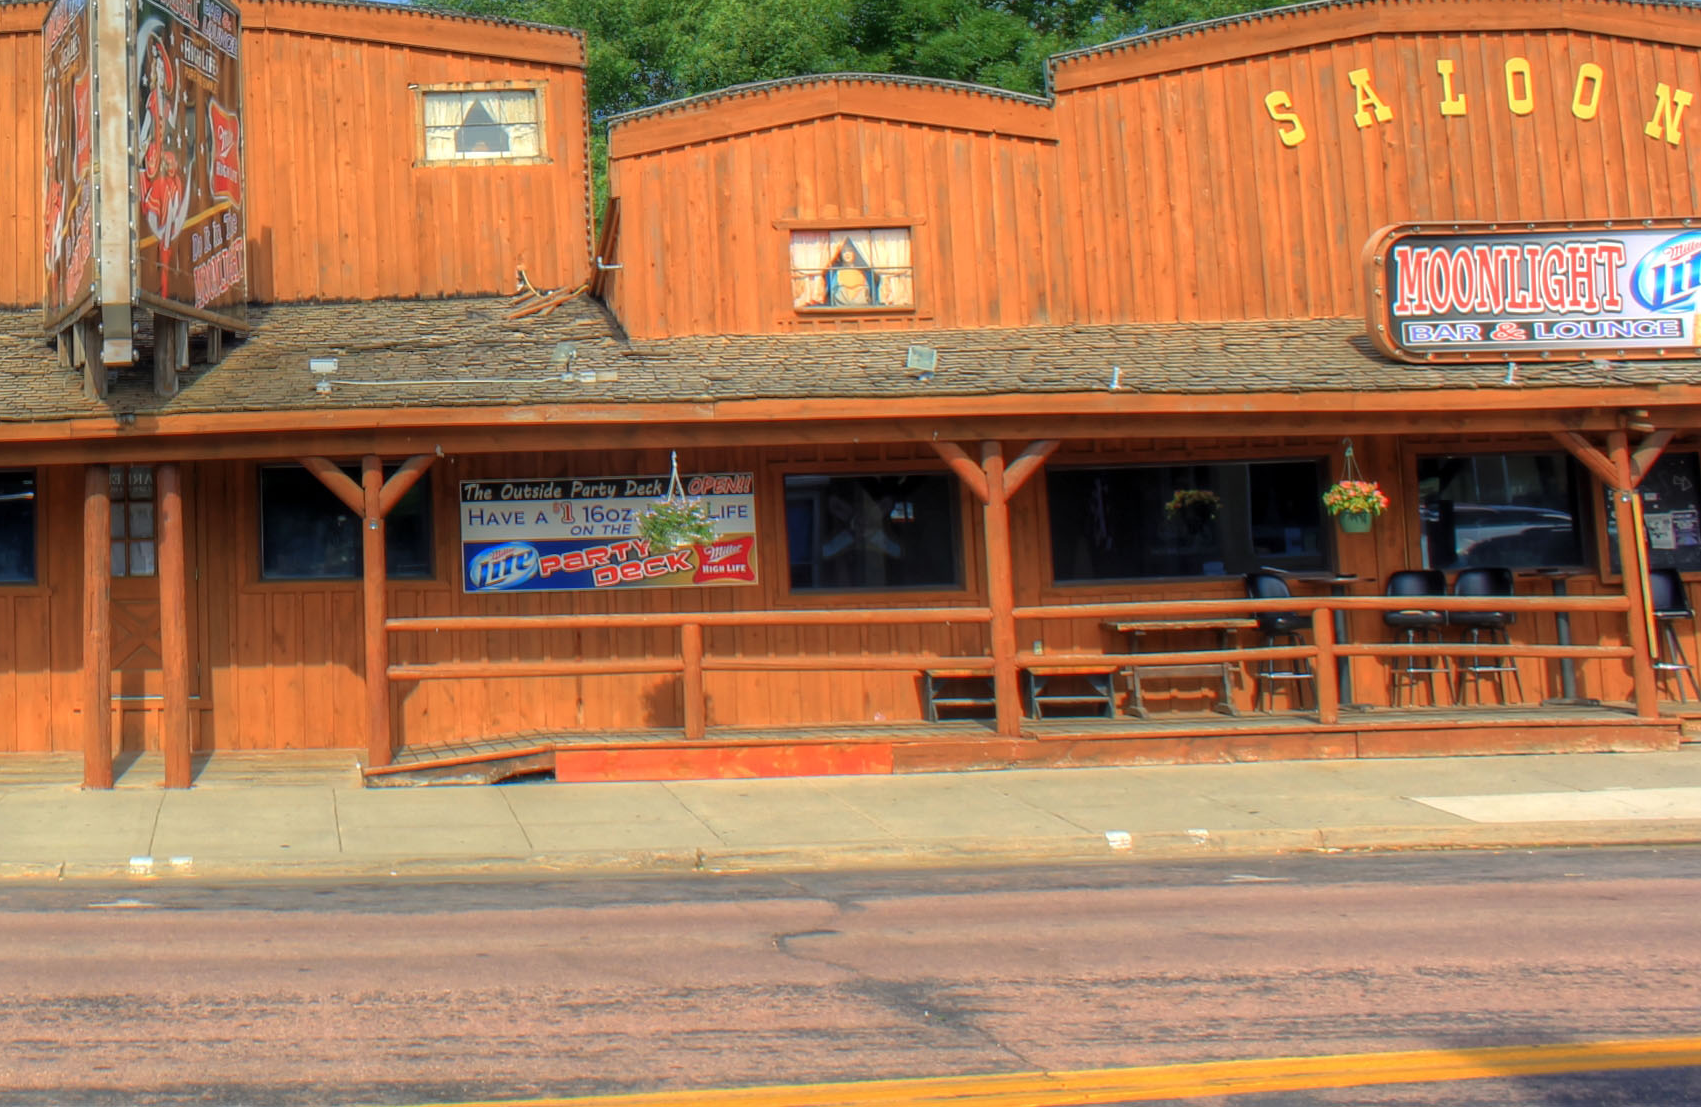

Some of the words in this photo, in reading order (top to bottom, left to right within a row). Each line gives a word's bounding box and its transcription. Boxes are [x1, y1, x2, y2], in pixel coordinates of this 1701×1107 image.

[1264, 57, 1693, 146] SALOON
[1393, 240, 1626, 316] MOONLIGHT
[1409, 323, 1482, 342] BAR
[1491, 322, 1526, 341] &
[1535, 319, 1681, 340] LOUNGE
[464, 483, 492, 500] The
[500, 482, 562, 500] Outside
[570, 480, 617, 499] Party
[624, 479, 662, 496] Deck
[688, 474, 752, 495] OPEN!!
[468, 507, 525, 526] HAVE
[535, 510, 549, 524] A
[570, 525, 594, 536] ON
[603, 524, 631, 535] THE
[703, 544, 743, 564] Miller
[702, 565, 725, 575] HIGH
[727, 564, 747, 573] LIFE
